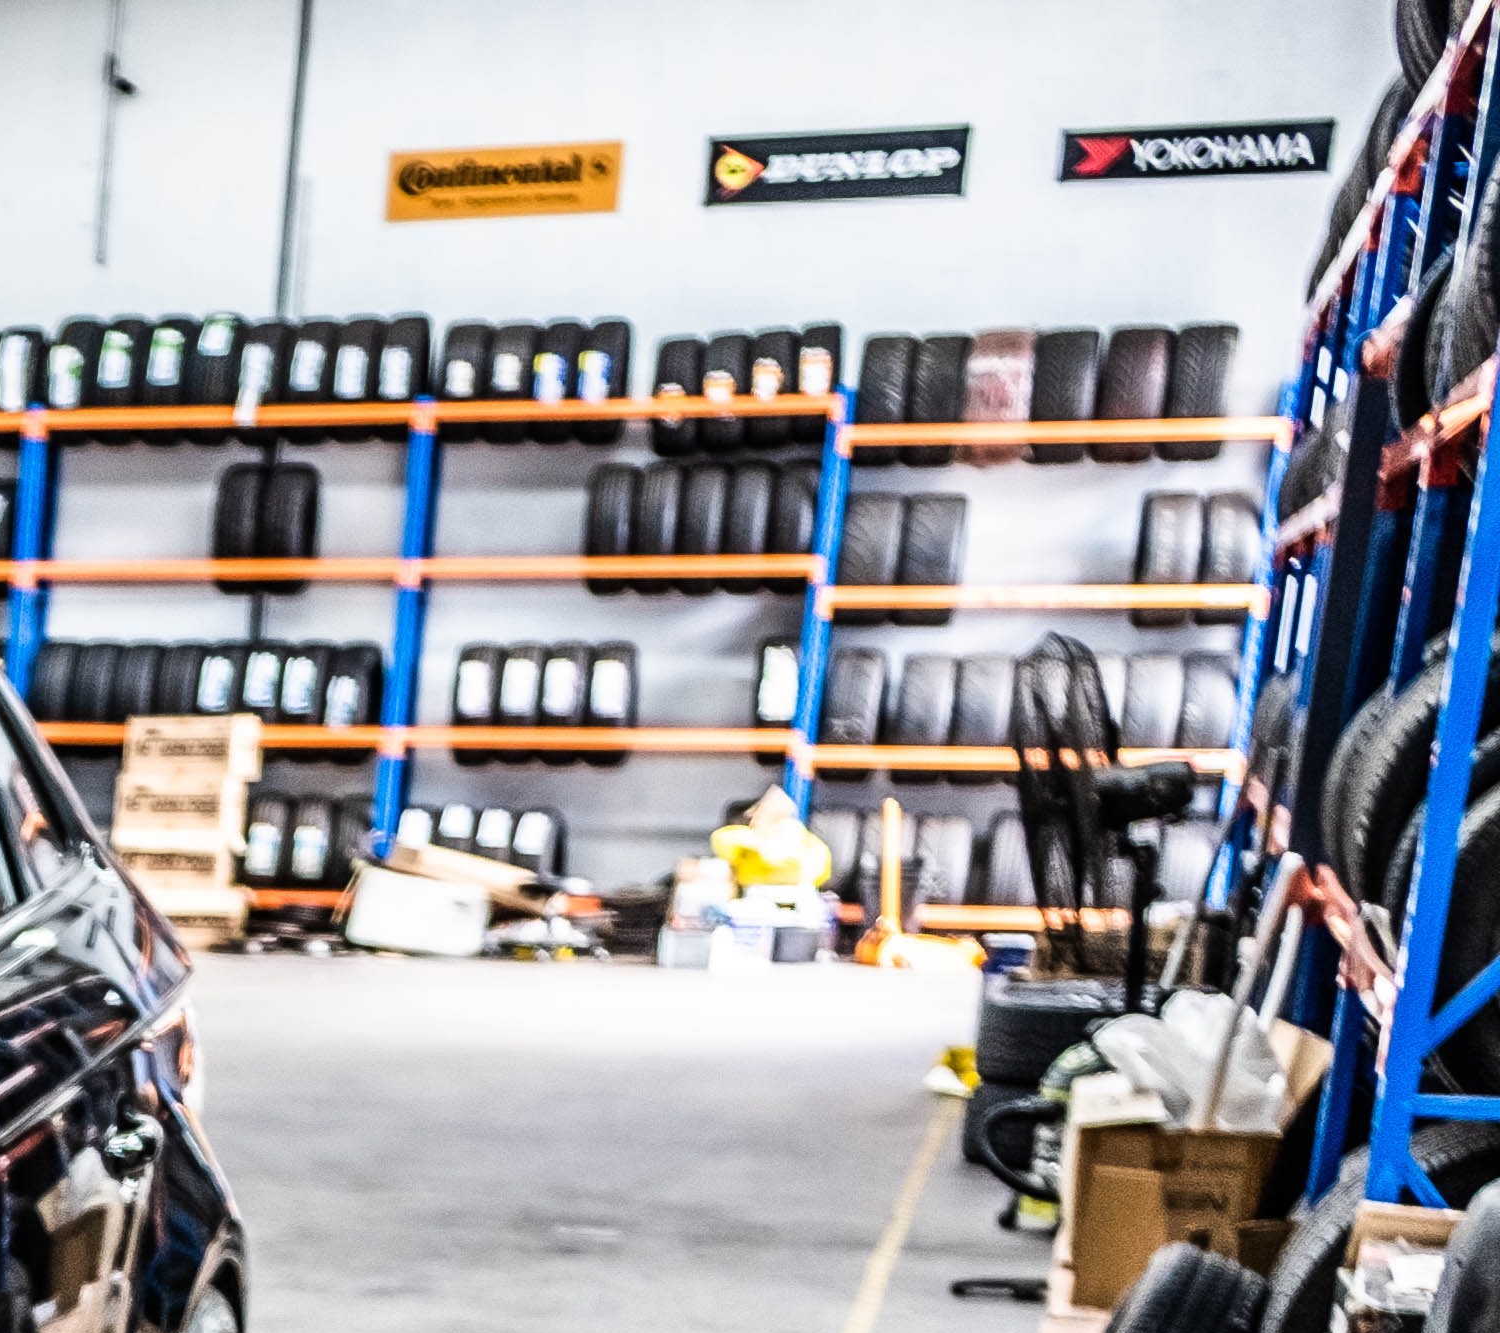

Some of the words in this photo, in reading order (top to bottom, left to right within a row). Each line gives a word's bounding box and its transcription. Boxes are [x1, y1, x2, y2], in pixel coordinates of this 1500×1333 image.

[762, 146, 962, 184] DUNLOP
[1129, 131, 1316, 172] YOKOHAMA
[398, 152, 583, 196] Continental
